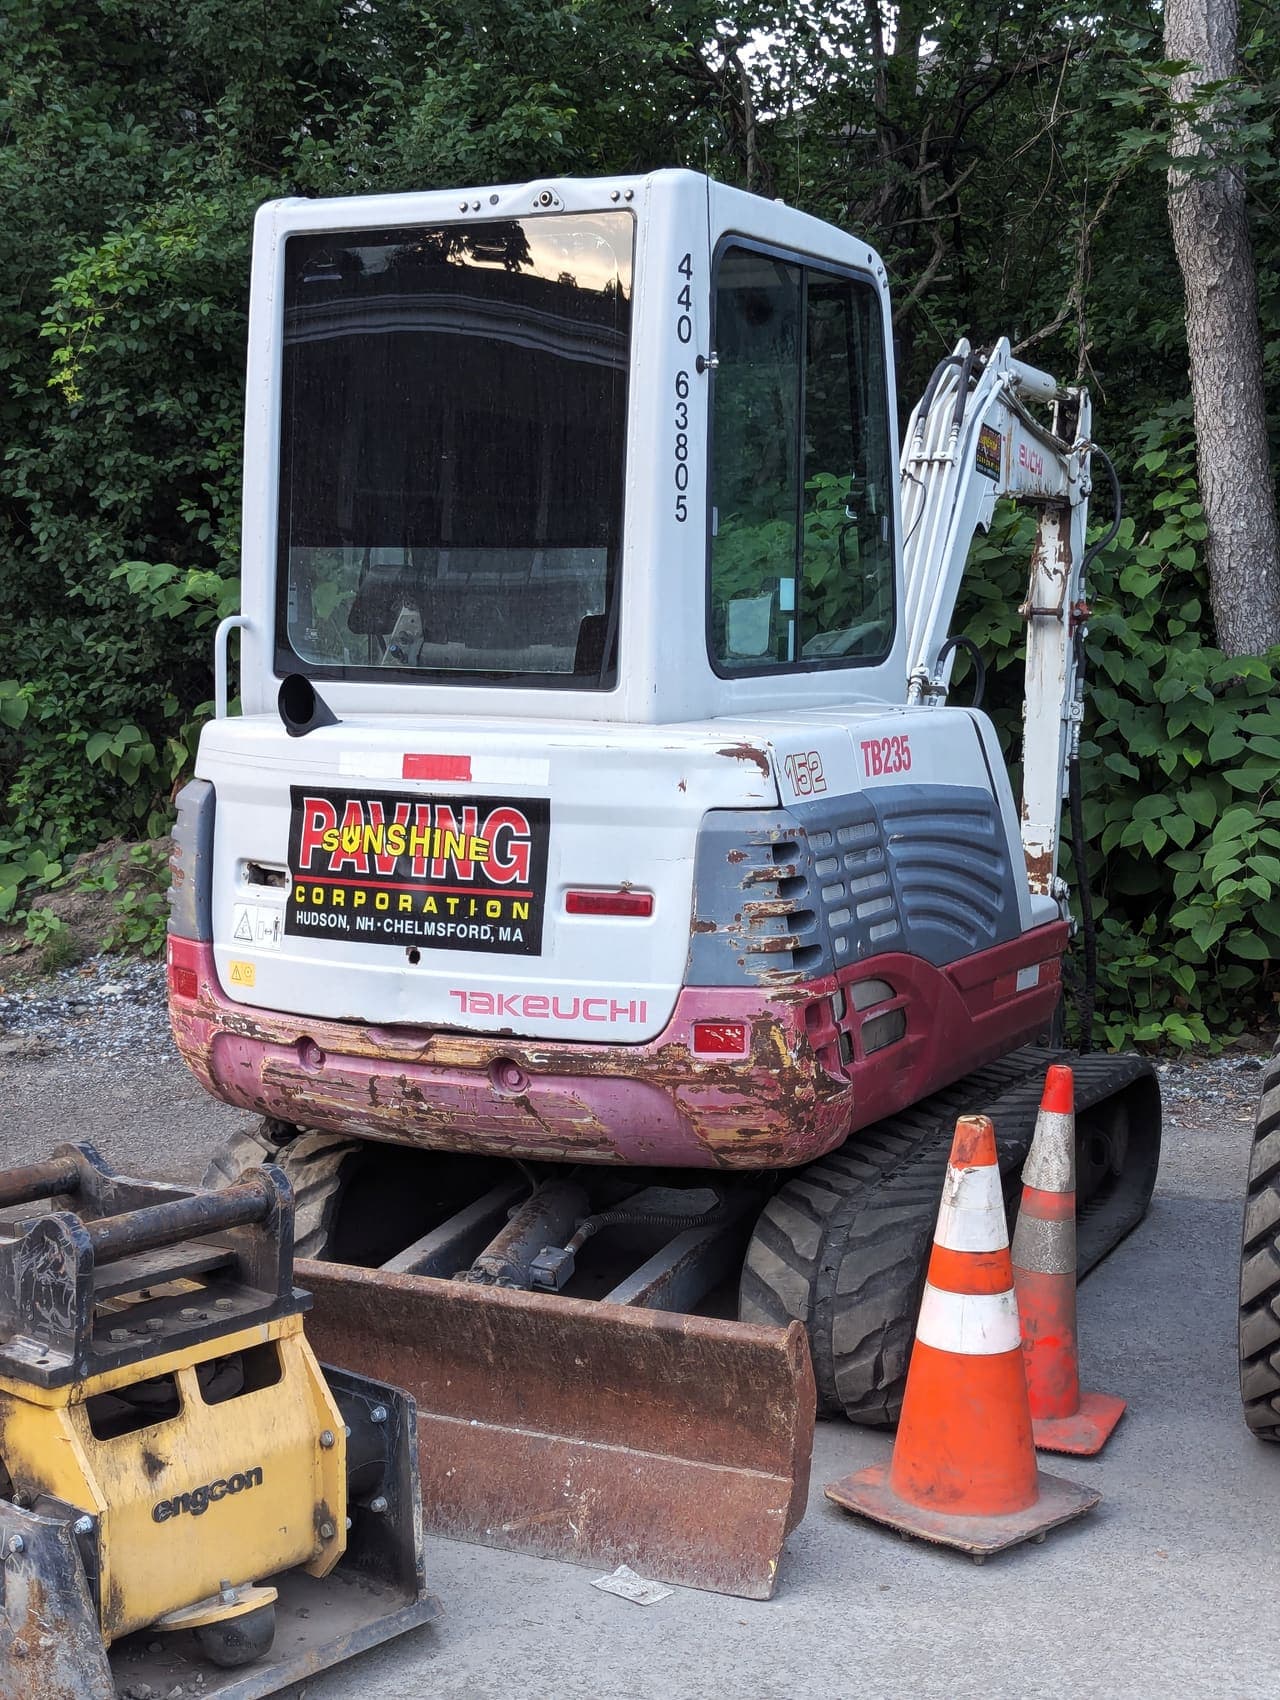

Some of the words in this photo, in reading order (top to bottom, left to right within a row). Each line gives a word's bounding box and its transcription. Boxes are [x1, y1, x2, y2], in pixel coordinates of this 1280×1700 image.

[677, 252, 693, 344] 440
[674, 370, 690, 523] 63805
[784, 751, 828, 797] 152
[860, 735, 912, 777] TB235
[299, 796, 532, 885] PAVING
[321, 818, 491, 863] SUNSHINE
[294, 885, 530, 920] CORPORATION
[296, 910, 351, 933] HUDSON,
[498, 926, 525, 943] MA
[152, 1466, 263, 1523] engcon
